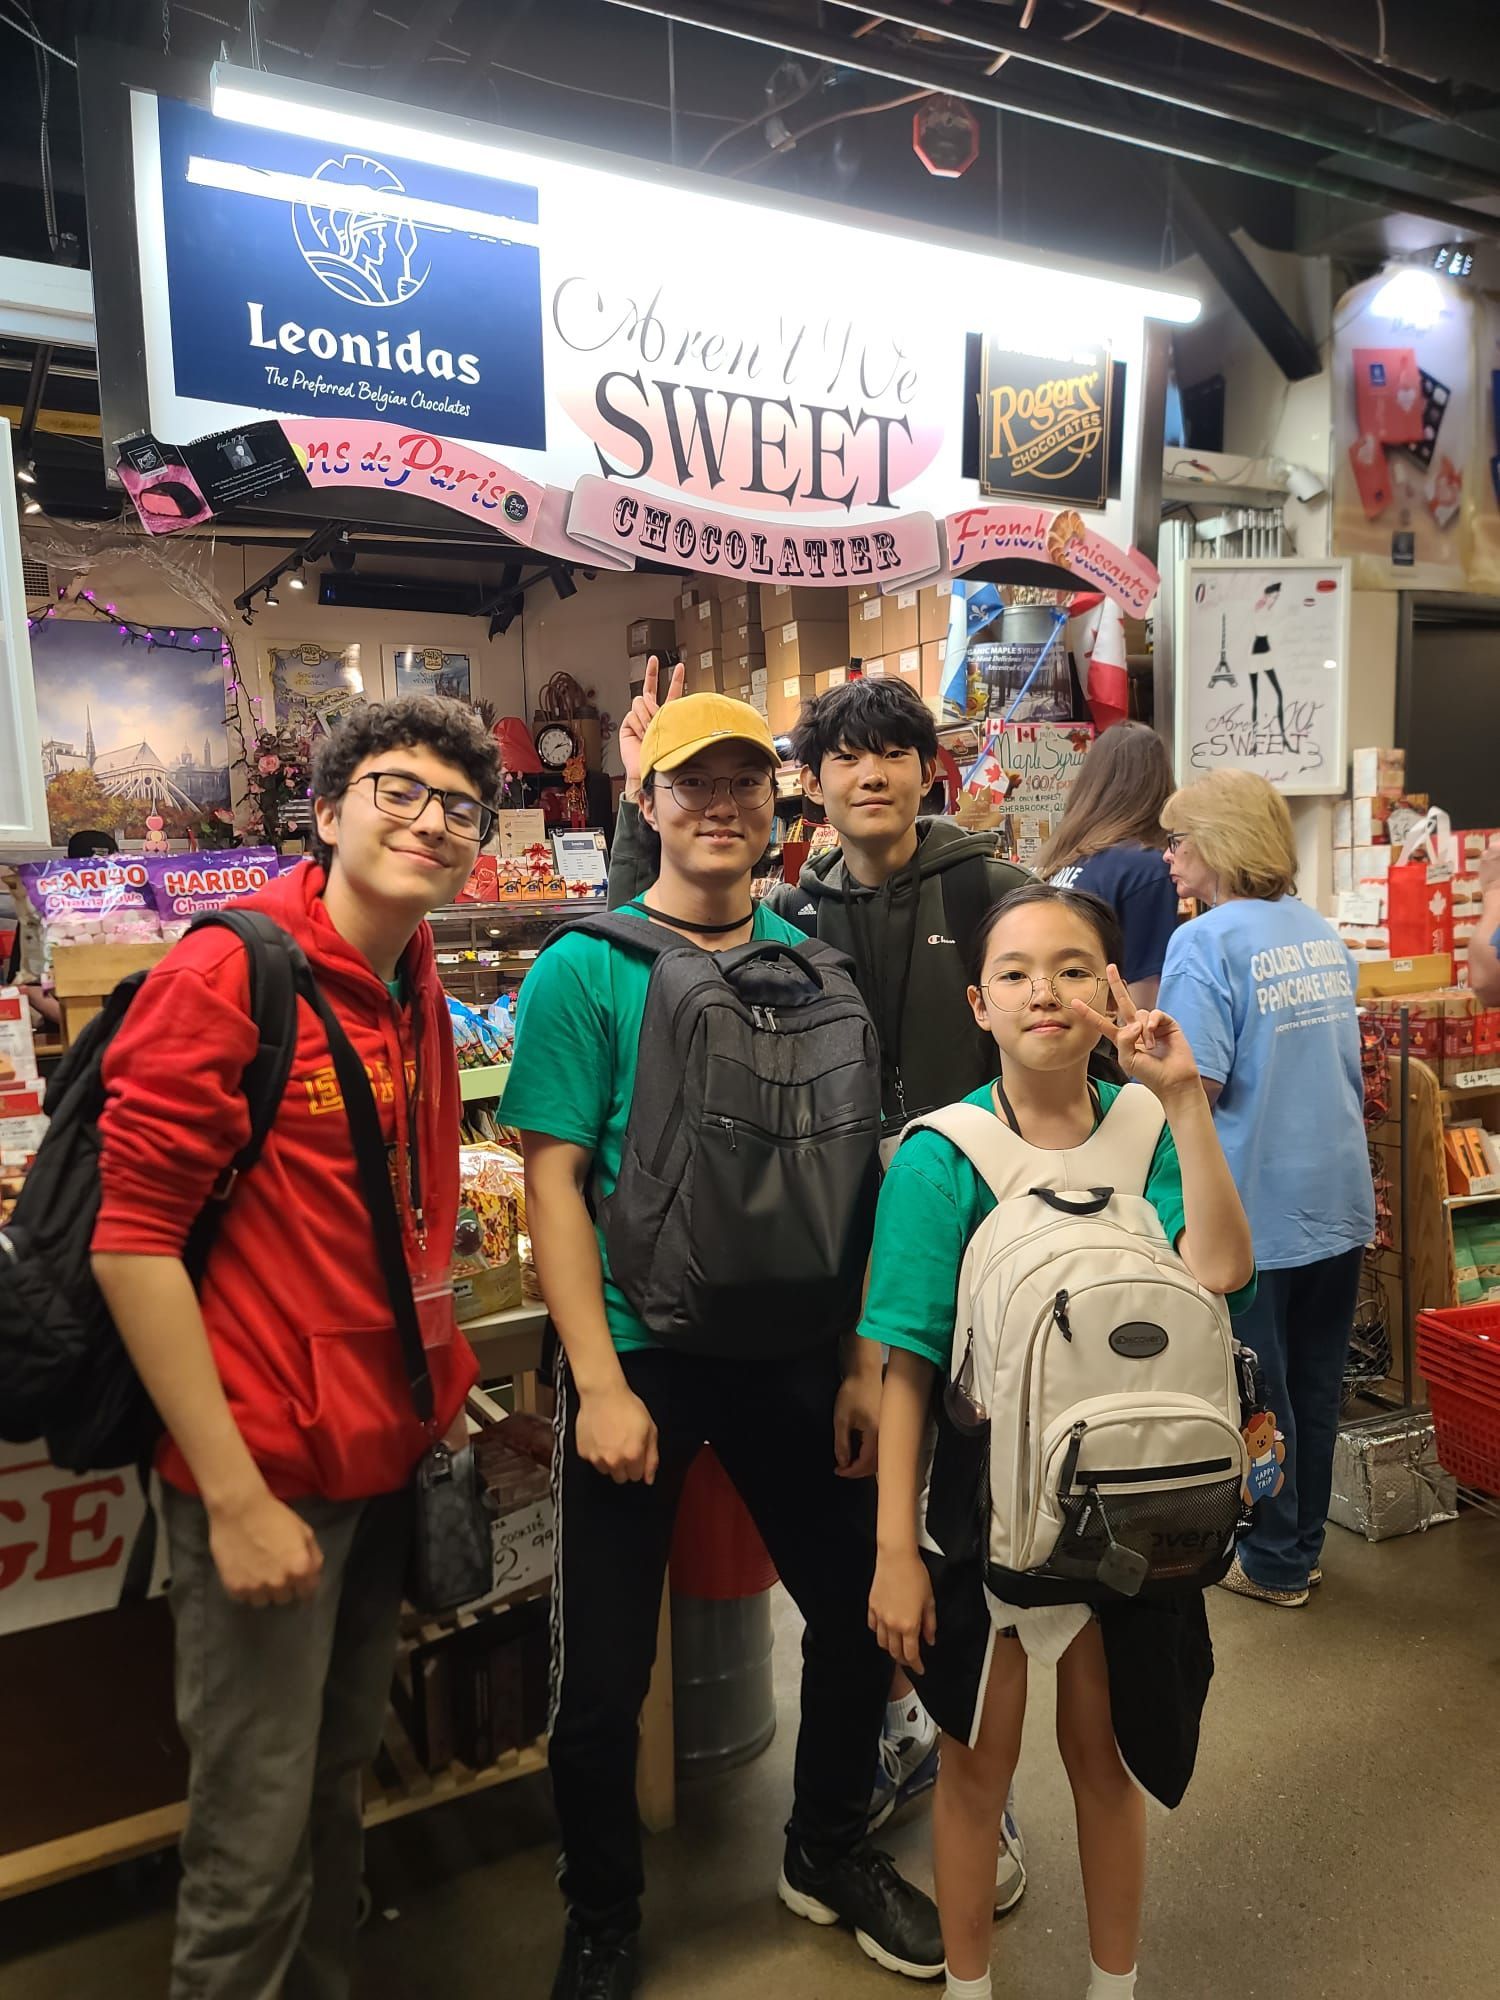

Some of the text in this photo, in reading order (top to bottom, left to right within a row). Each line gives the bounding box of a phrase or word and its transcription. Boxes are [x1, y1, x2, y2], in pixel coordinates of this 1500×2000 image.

[247, 301, 481, 385] Leonidas
[264, 366, 471, 417] The Preferred Belgian Chocolates
[593, 369, 914, 514] SWEET
[1011, 412, 1102, 469] CHOCOLATES
[360, 441, 392, 473] de
[384, 434, 506, 510] Paris
[612, 496, 902, 578] CHOCOLATIER
[951, 509, 1047, 566] French
[991, 647, 1016, 655] MAPLE
[1017, 647, 1040, 655] SYRUP
[992, 730, 1086, 781] Maple Syru
[165, 868, 268, 896] HARIBO
[1250, 944, 1305, 982] GOLDEN
[1256, 973, 1326, 1015] PANCAKE
[1255, 1465, 1275, 1483] HAPPY
